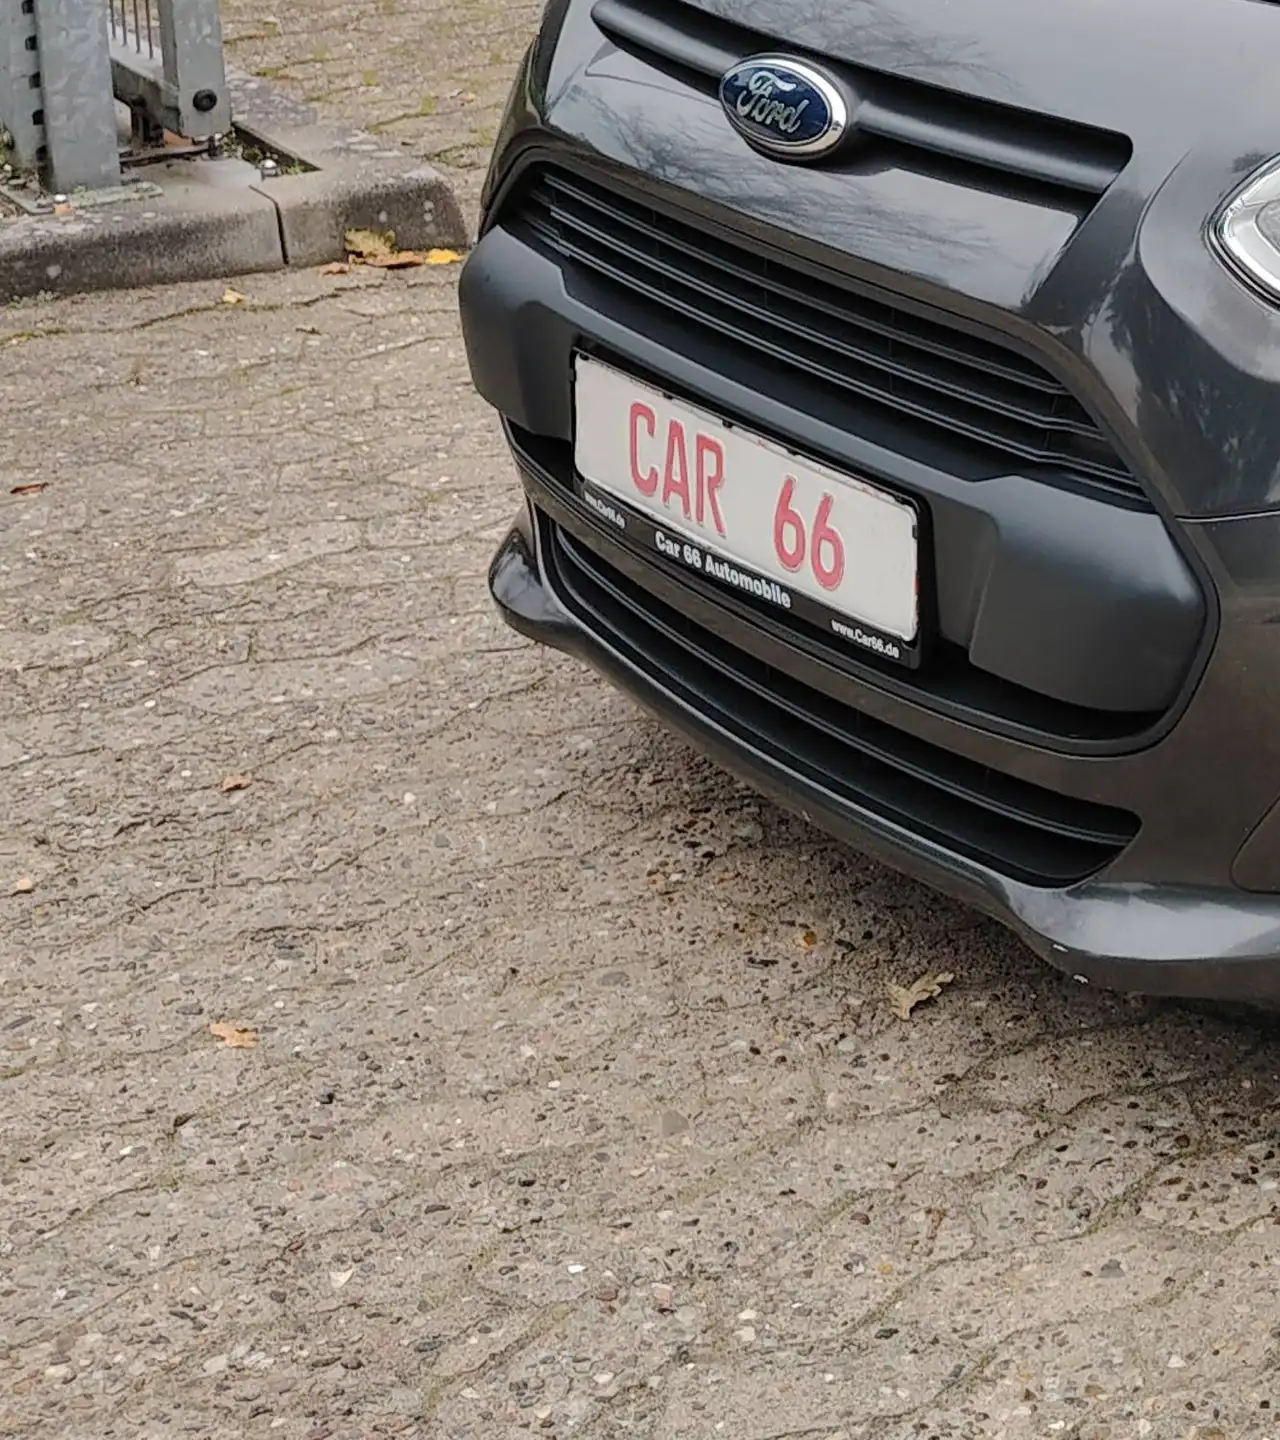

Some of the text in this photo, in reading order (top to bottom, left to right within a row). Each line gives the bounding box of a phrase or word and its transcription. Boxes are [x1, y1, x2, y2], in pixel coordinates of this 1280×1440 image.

[737, 70, 810, 134] Ford
[629, 401, 846, 592] CAR 66
[655, 530, 792, 609] Car 66 Automobile
[831, 618, 900, 660] www.Car66.de
